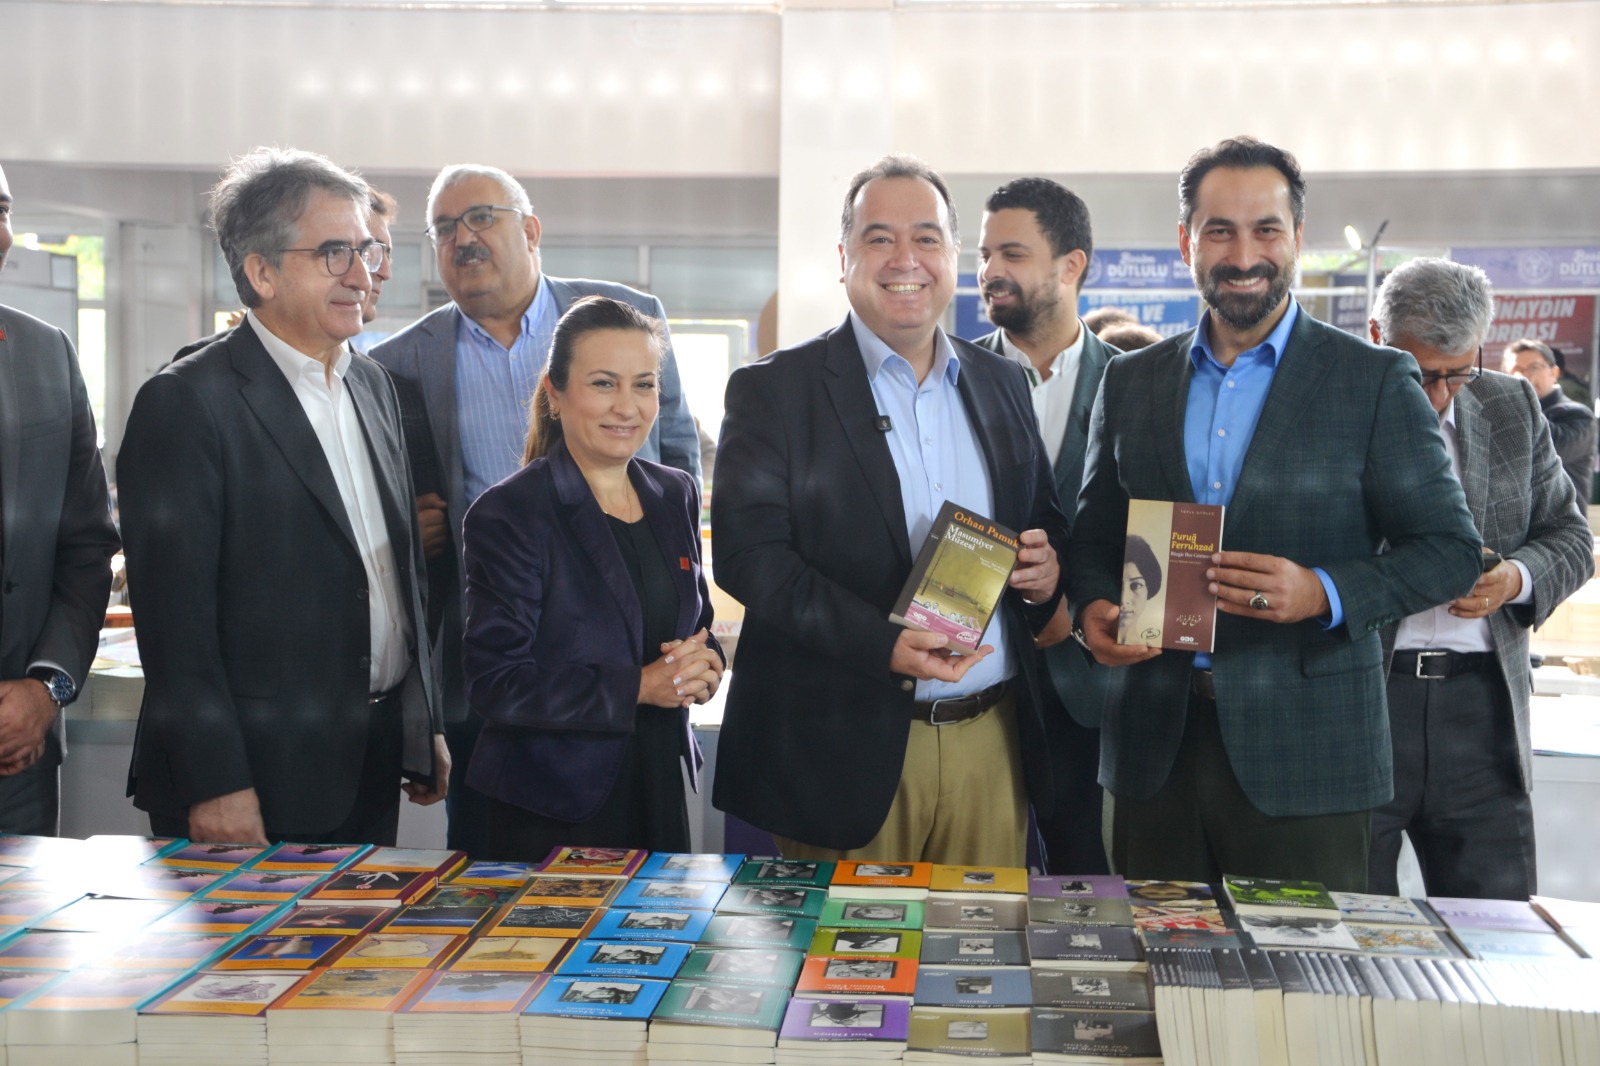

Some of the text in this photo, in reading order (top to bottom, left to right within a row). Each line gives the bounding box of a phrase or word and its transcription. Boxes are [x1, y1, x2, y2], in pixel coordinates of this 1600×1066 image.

[1107, 263, 1168, 277] DUTLULU
[947, 524, 994, 551] Masumiyet
[954, 511, 1020, 549] Orhan Pamuk
[1172, 532, 1197, 544] Furuğ
[944, 531, 976, 551] Müzesi
[1171, 541, 1214, 551] Ferruhzad
